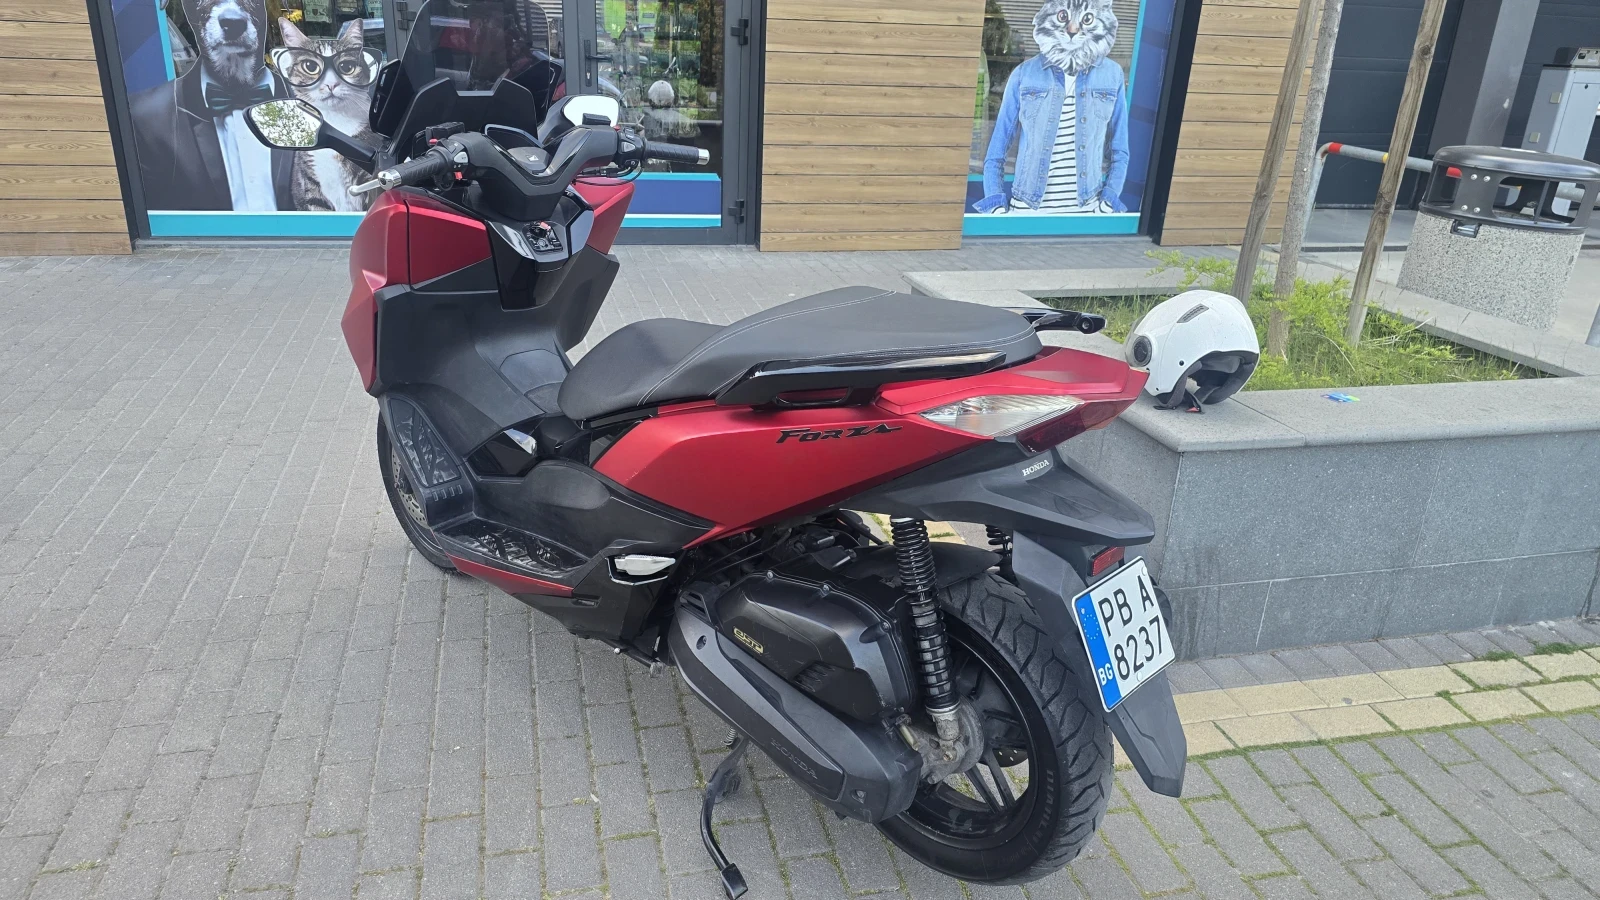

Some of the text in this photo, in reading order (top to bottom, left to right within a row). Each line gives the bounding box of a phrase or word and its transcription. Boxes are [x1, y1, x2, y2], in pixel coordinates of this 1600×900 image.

[776, 423, 903, 444] FORZA
[1021, 459, 1050, 477] HONDA
[1098, 574, 1155, 638] PB A
[1113, 615, 1163, 681] 8237
[1097, 662, 1114, 687] BG
[770, 737, 818, 780] HONDA
